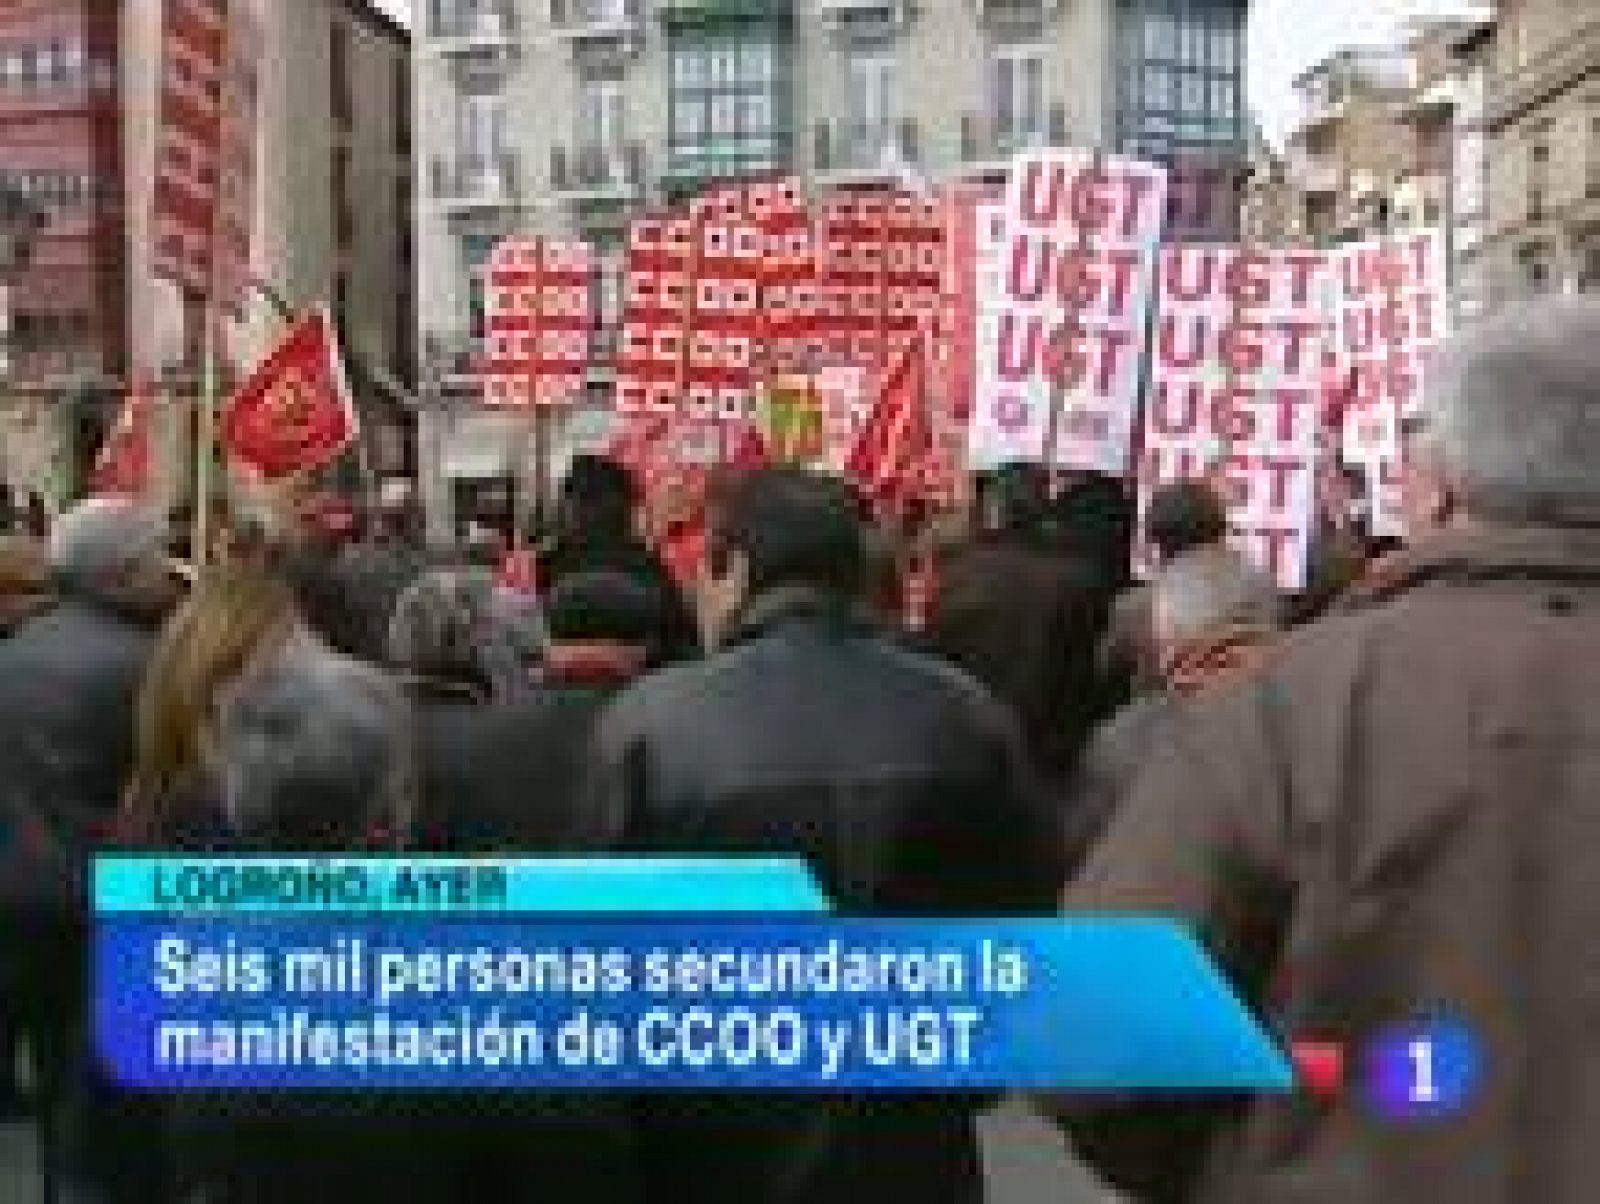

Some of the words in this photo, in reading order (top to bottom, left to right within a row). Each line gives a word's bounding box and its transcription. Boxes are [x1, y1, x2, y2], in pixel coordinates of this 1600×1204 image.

[1020, 160, 1154, 238] UGT
[1008, 236, 1139, 318] UGT
[1164, 252, 1323, 306] UGT
[997, 313, 1131, 396] UGT
[1158, 315, 1316, 374] UGT
[1152, 382, 1311, 442] UGT
